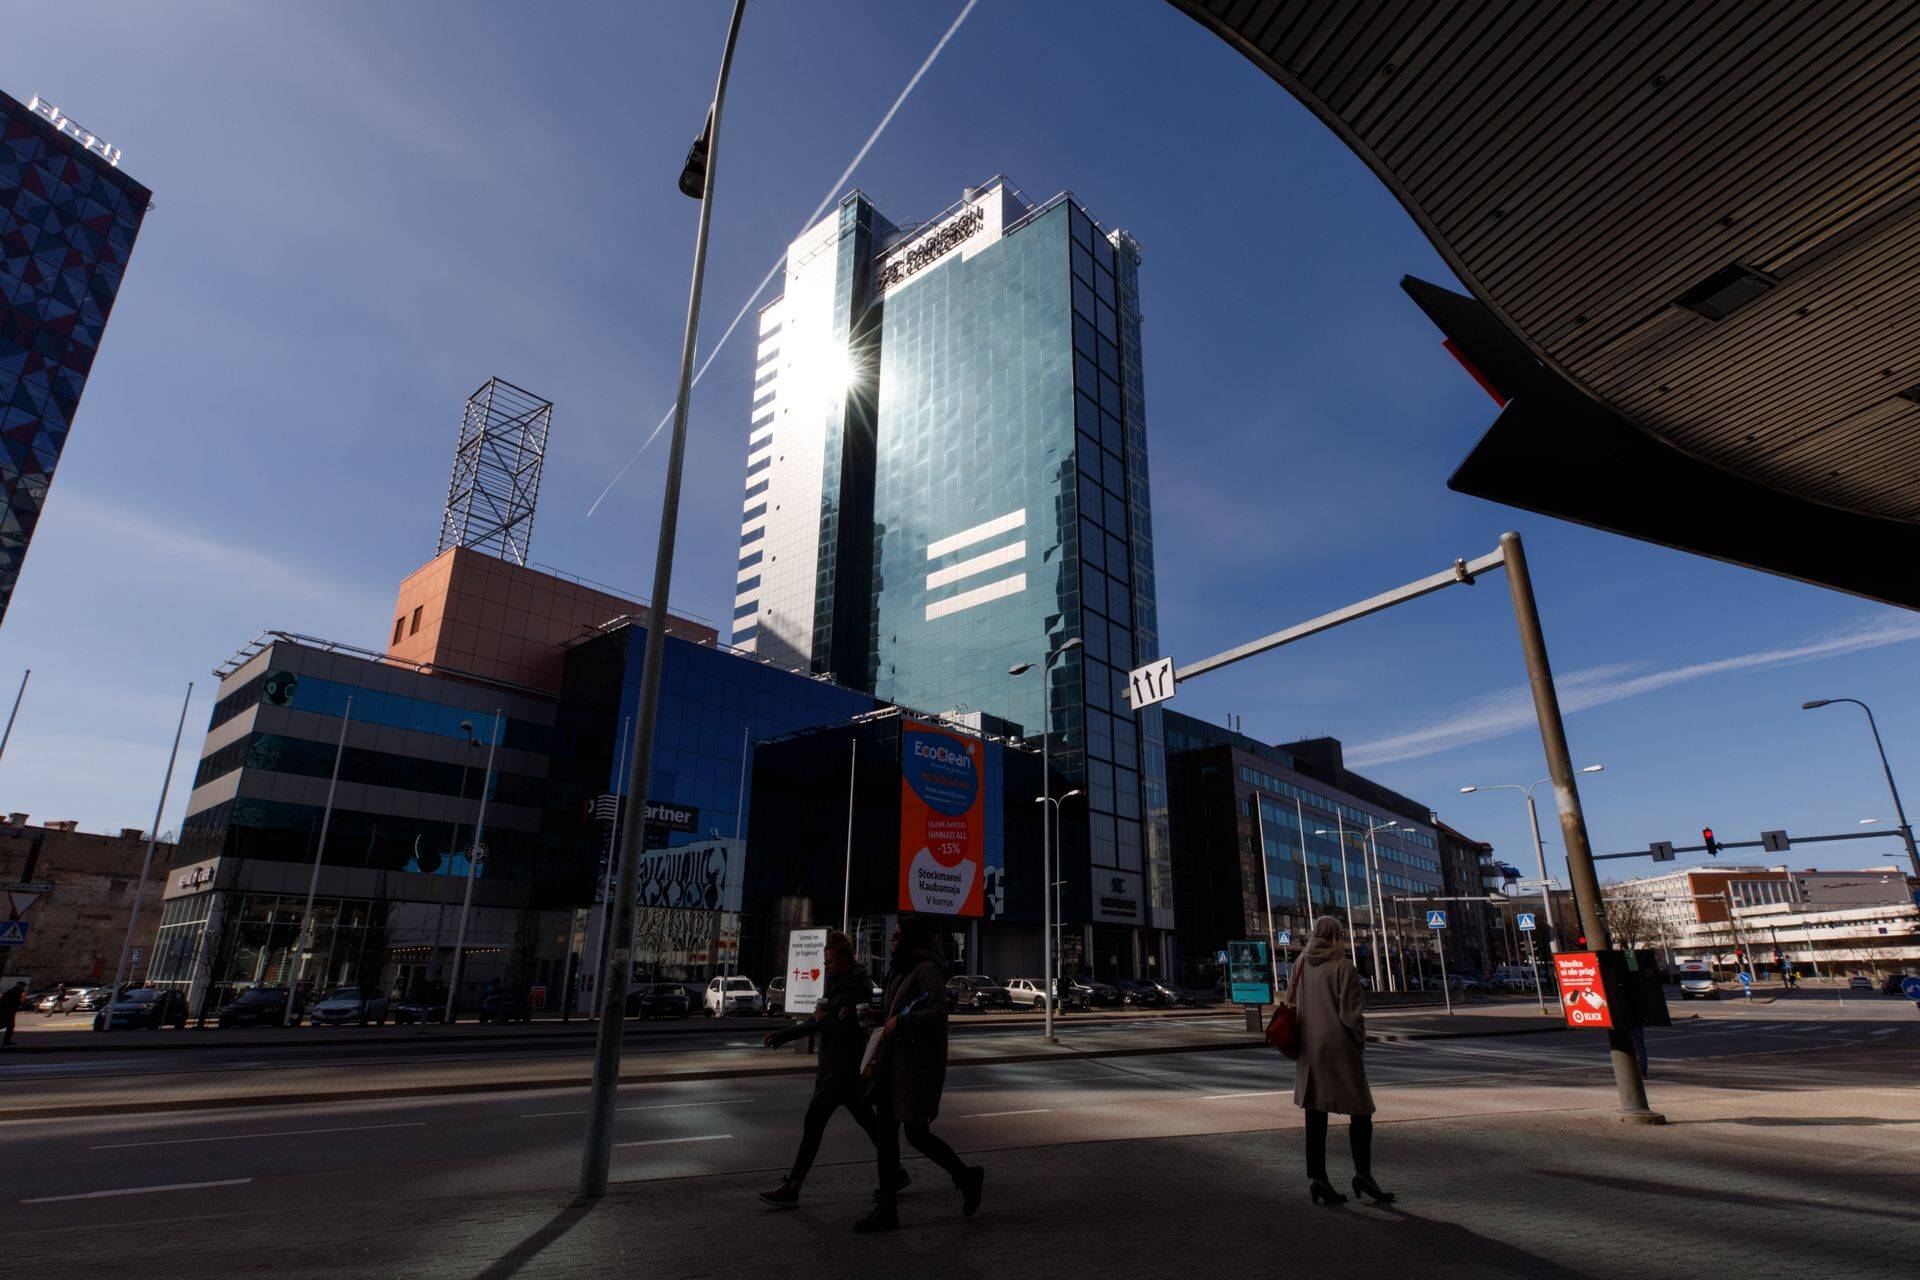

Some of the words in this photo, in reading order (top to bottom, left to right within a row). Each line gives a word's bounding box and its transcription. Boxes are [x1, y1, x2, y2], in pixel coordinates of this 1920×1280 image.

[914, 740, 971, 769] EcoClean
[645, 804, 692, 824] artner
[928, 831, 955, 840] HINNAD
[956, 831, 967, 840] ALL
[937, 842, 961, 855] -15%
[918, 868, 961, 883] Stockmanni
[919, 881, 960, 895] Kaubamaja
[926, 896, 932, 905] V
[932, 896, 953, 907] korrus
[1584, 1012, 1603, 1021] KLICK
